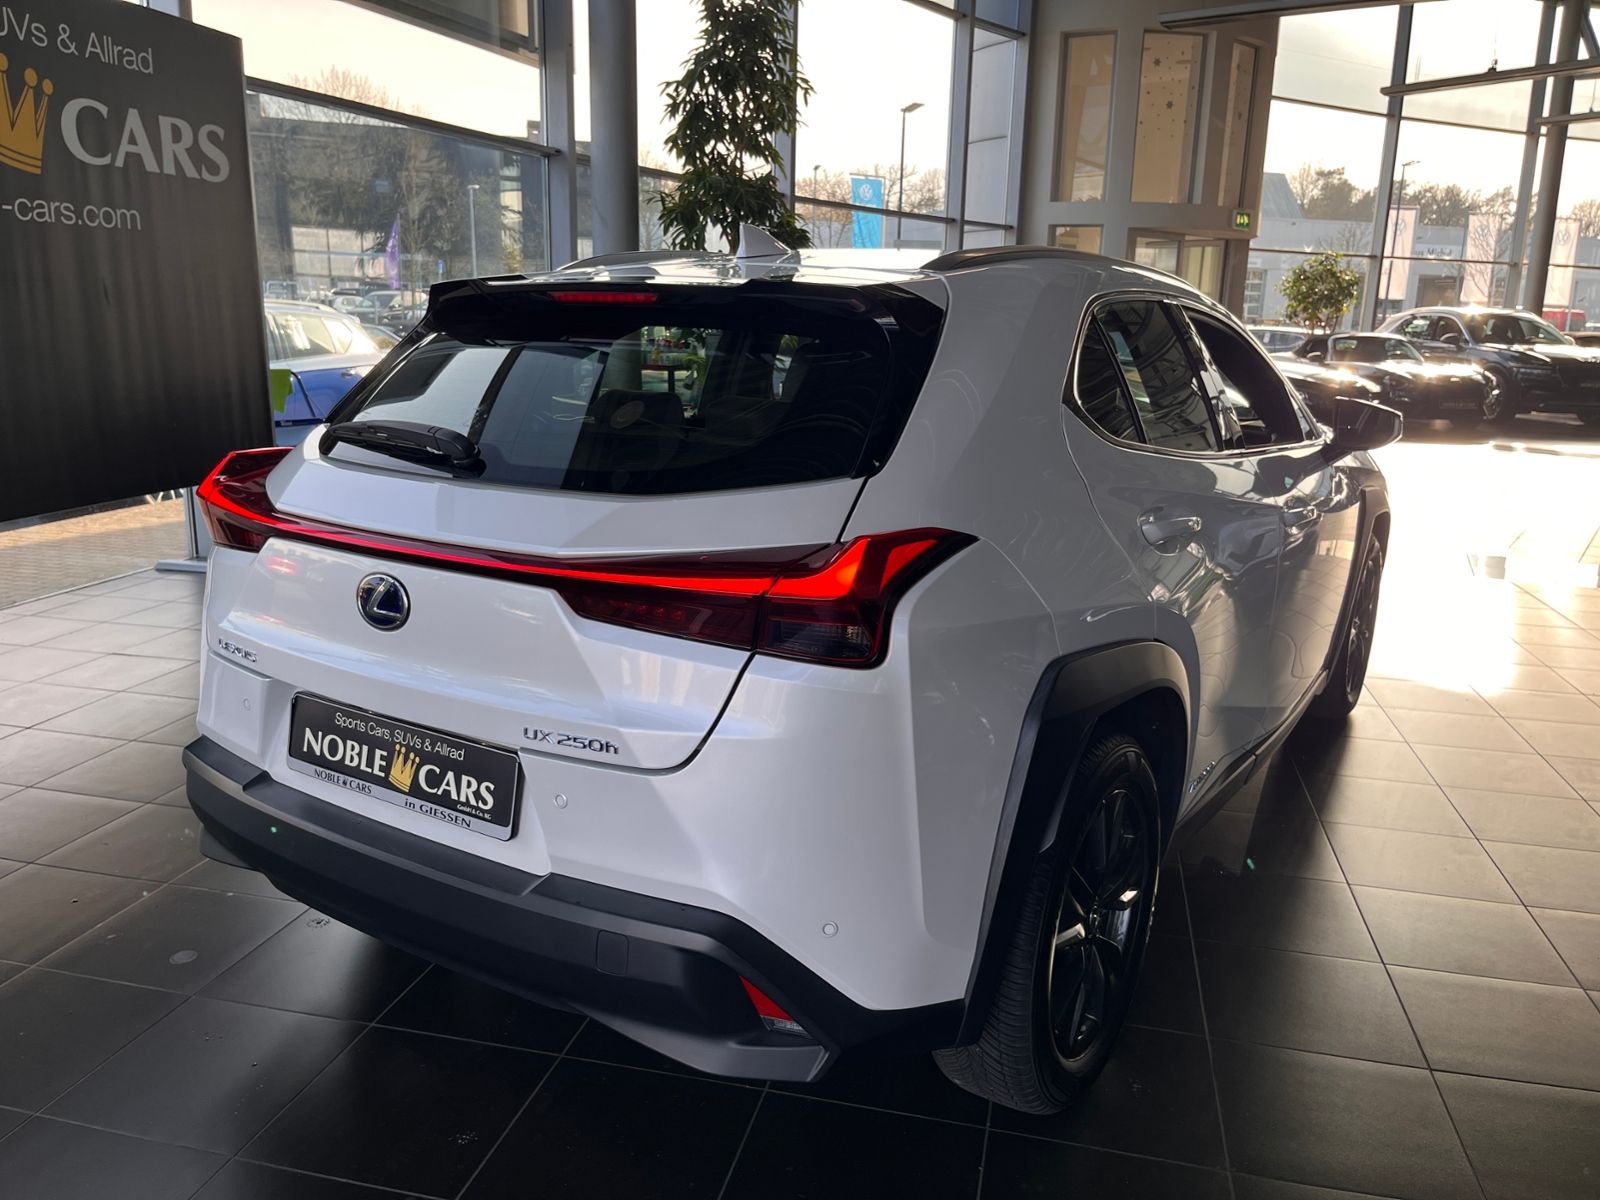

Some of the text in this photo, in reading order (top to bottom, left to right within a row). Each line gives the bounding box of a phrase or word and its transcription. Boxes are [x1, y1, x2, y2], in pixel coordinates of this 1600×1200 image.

[56, 23, 79, 56] &
[85, 32, 154, 74] Allrad
[60, 97, 230, 183] CARS
[335, 712, 465, 761] Sports Cars, SUVs & Allrad
[523, 727, 619, 755] UX 250h
[303, 727, 495, 810] NOBLE CARS
[314, 768, 372, 794] NOBLE CARS
[404, 798, 472, 828] in GIESSEN
